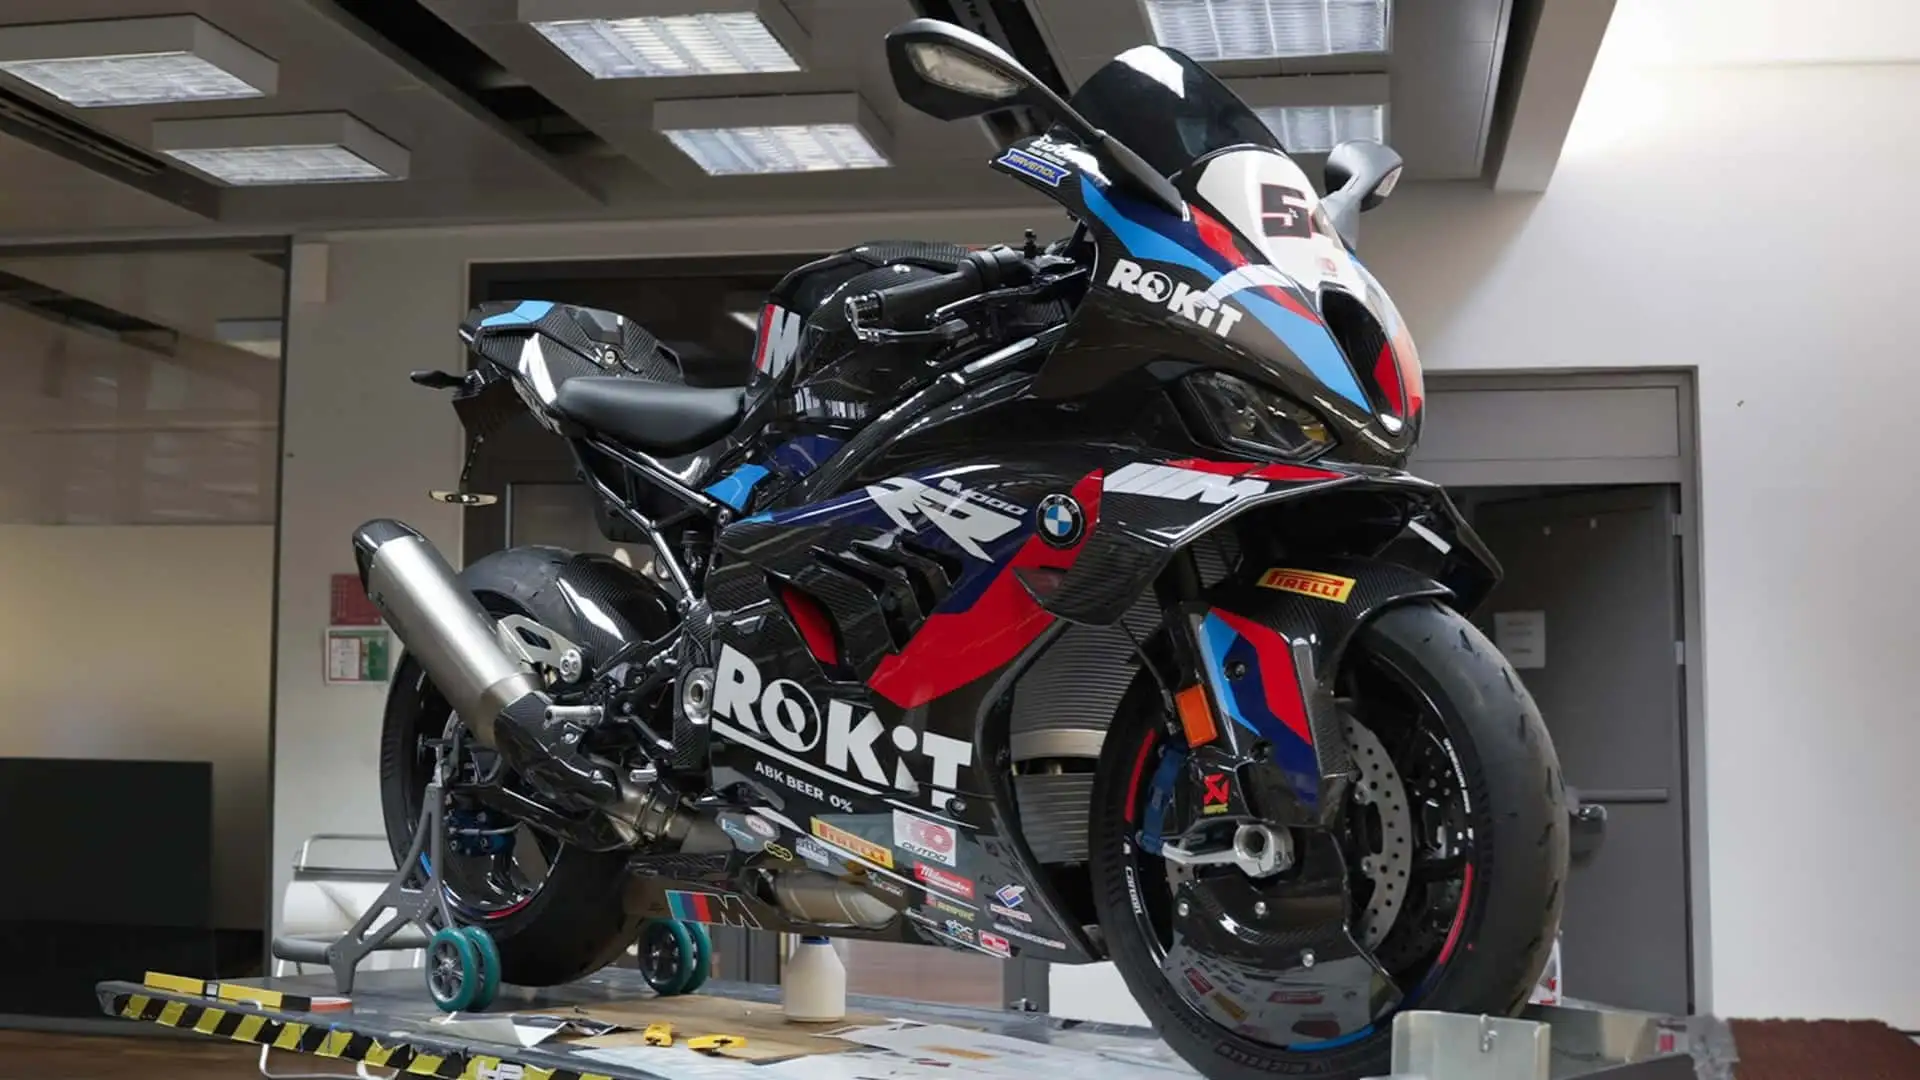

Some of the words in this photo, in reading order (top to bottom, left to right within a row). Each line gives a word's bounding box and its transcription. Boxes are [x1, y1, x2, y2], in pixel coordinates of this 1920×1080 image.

[1266, 570, 1345, 598] PIRELLI
[754, 761, 785, 784] ABK
[785, 774, 825, 801] BEER
[829, 794, 853, 813] 0%
